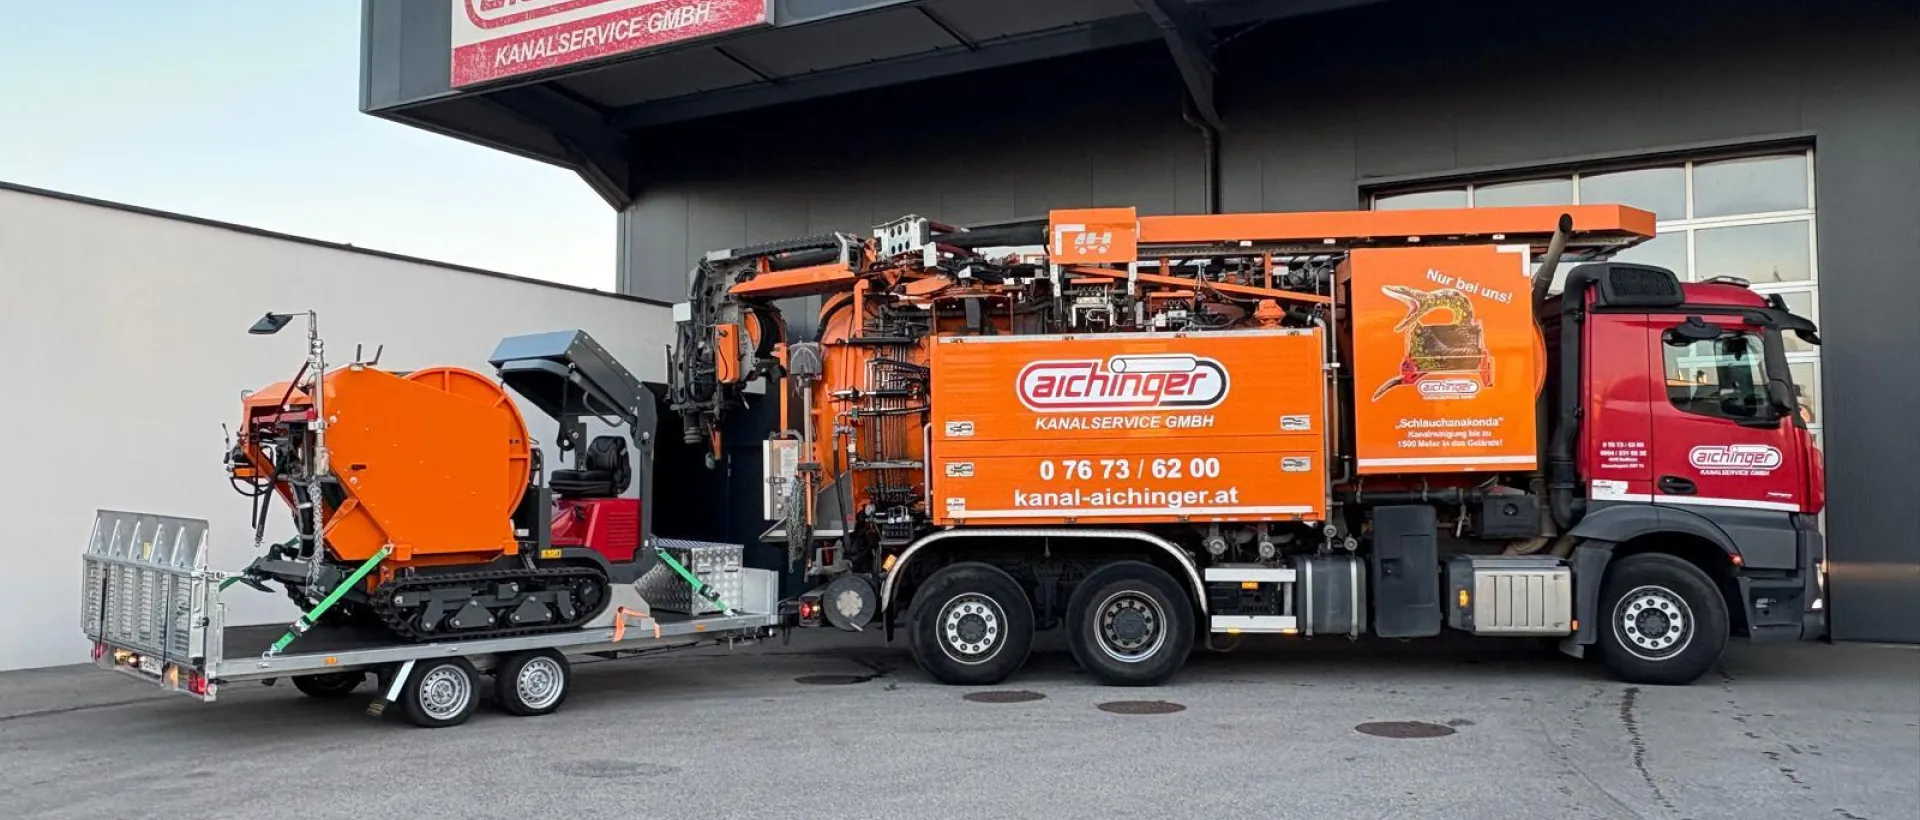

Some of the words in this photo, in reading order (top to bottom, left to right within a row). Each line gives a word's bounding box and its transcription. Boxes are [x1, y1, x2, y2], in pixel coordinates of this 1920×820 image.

[494, 16, 644, 68] KANALSERVICE
[647, 1, 711, 34] GMBH
[1426, 268, 1454, 285] Nur
[1455, 276, 1479, 293] bei
[1481, 287, 1513, 304] uns!
[1031, 361, 1208, 407] aichinger
[1035, 415, 1161, 430] KANALSERVICE
[1165, 414, 1214, 428] GMBH
[1696, 446, 1774, 467] aichinger
[1039, 460, 1055, 480] 0
[1062, 459, 1093, 480] 76
[1100, 459, 1130, 479] 73
[1137, 458, 1145, 479] /
[1151, 458, 1182, 479] 62
[1190, 457, 1220, 478] 00
[1014, 486, 1239, 509] kanal-aichinger.at
